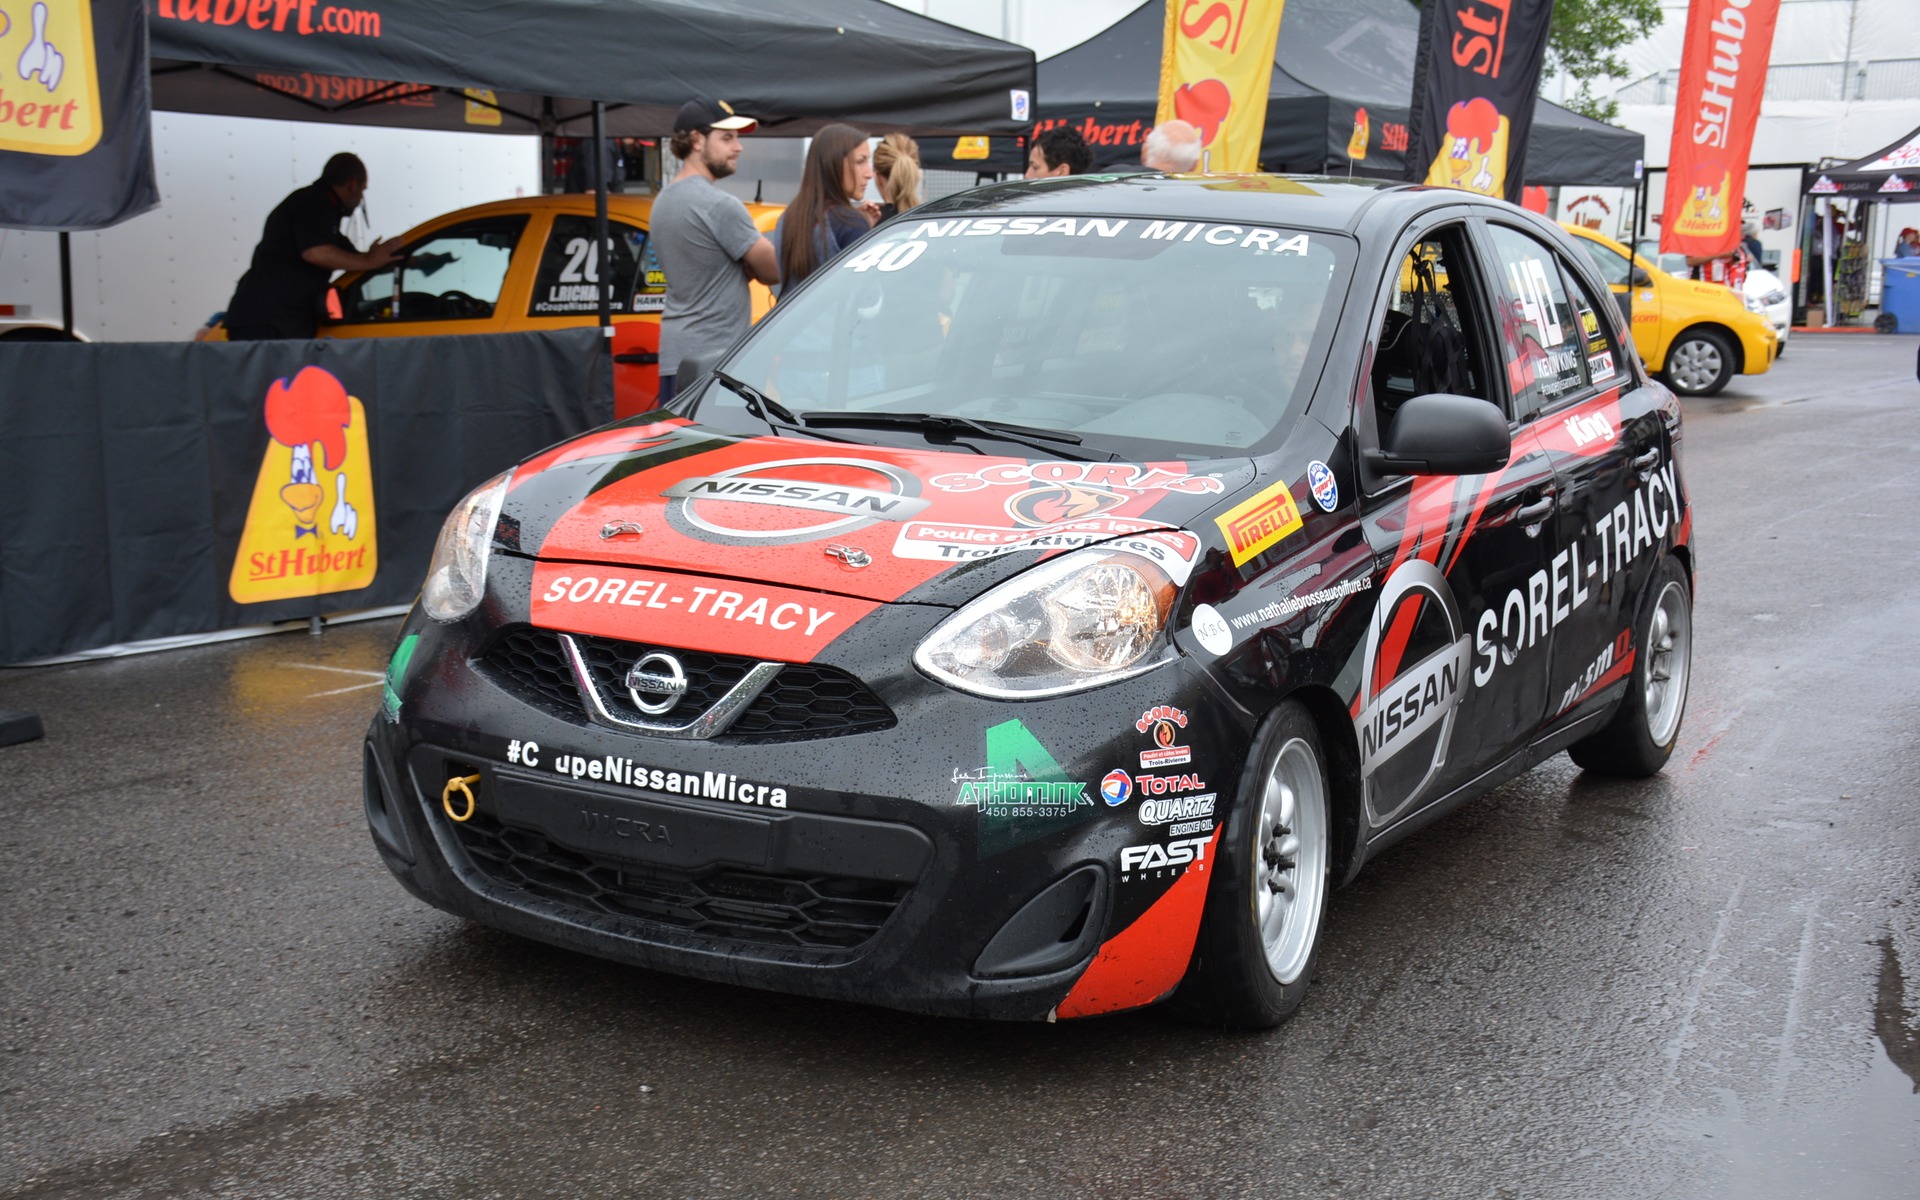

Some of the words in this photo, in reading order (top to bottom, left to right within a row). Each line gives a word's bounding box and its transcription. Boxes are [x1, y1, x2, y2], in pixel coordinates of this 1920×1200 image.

[1452, 0, 1511, 79] St
[909, 217, 1129, 239] NISSAN
[1139, 219, 1311, 256] MICRA
[842, 239, 929, 273] 40
[1510, 258, 1564, 349] 40
[1564, 411, 1616, 447] King
[688, 481, 902, 513] NISSAN
[918, 527, 999, 543] Poulet
[1227, 493, 1294, 554] PIRELLI
[249, 544, 367, 581] StHubert
[1473, 461, 1680, 688] SOREL-TRACY
[543, 576, 837, 637] SOREL-TRACY
[630, 676, 677, 690] NISSAN
[1136, 705, 1189, 733] SCORES
[1361, 656, 1461, 766] NISSAN
[1136, 773, 1206, 796] TOTAL
[985, 807, 1008, 817] 450
[1011, 807, 1067, 817] 855-3375
[1138, 792, 1218, 826] QUARTZ
[580, 810, 674, 847] MICRA
[1169, 822, 1199, 837] ENGINE
[1199, 819, 1214, 832] OIL
[1120, 835, 1214, 872] FAST
